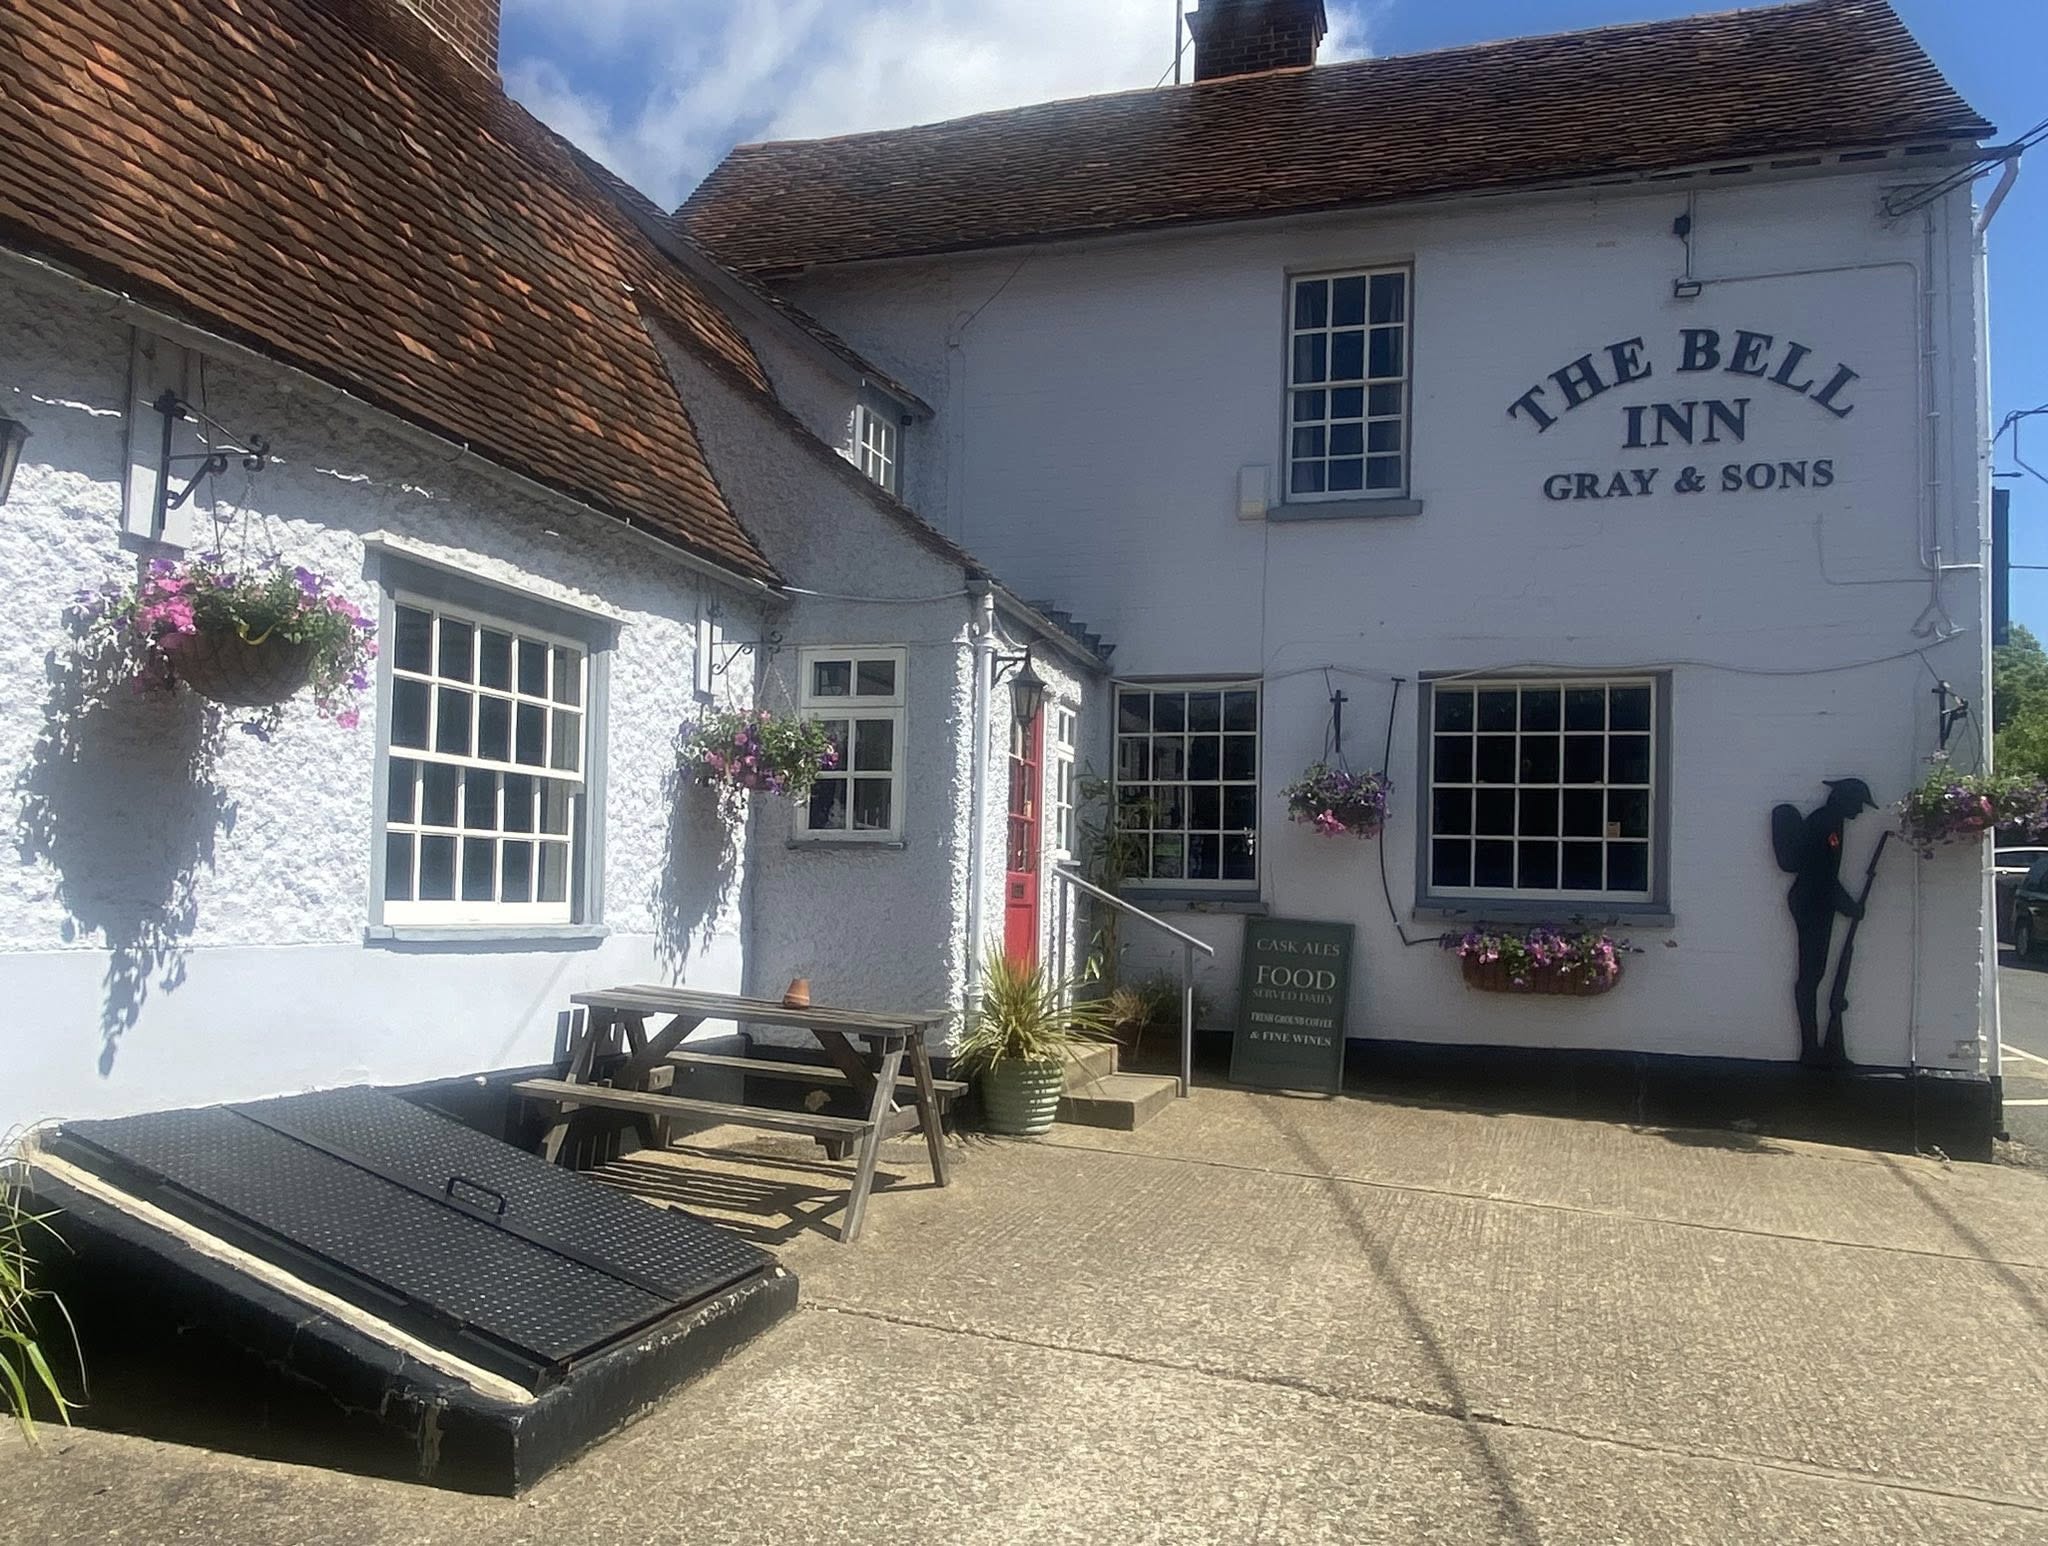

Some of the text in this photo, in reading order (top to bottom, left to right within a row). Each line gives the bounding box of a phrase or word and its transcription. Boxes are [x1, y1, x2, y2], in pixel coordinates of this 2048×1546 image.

[1507, 329, 1860, 433] THE BELL
[1622, 398, 1750, 449] INN
[1543, 459, 1834, 501] GRAY & SONS
[1257, 938, 1340, 957] CASK ALES
[1256, 965, 1336, 990] FOOD
[1252, 988, 1334, 1005] SERVED DAILY
[1249, 1031, 1331, 1046] & FINE WINES
